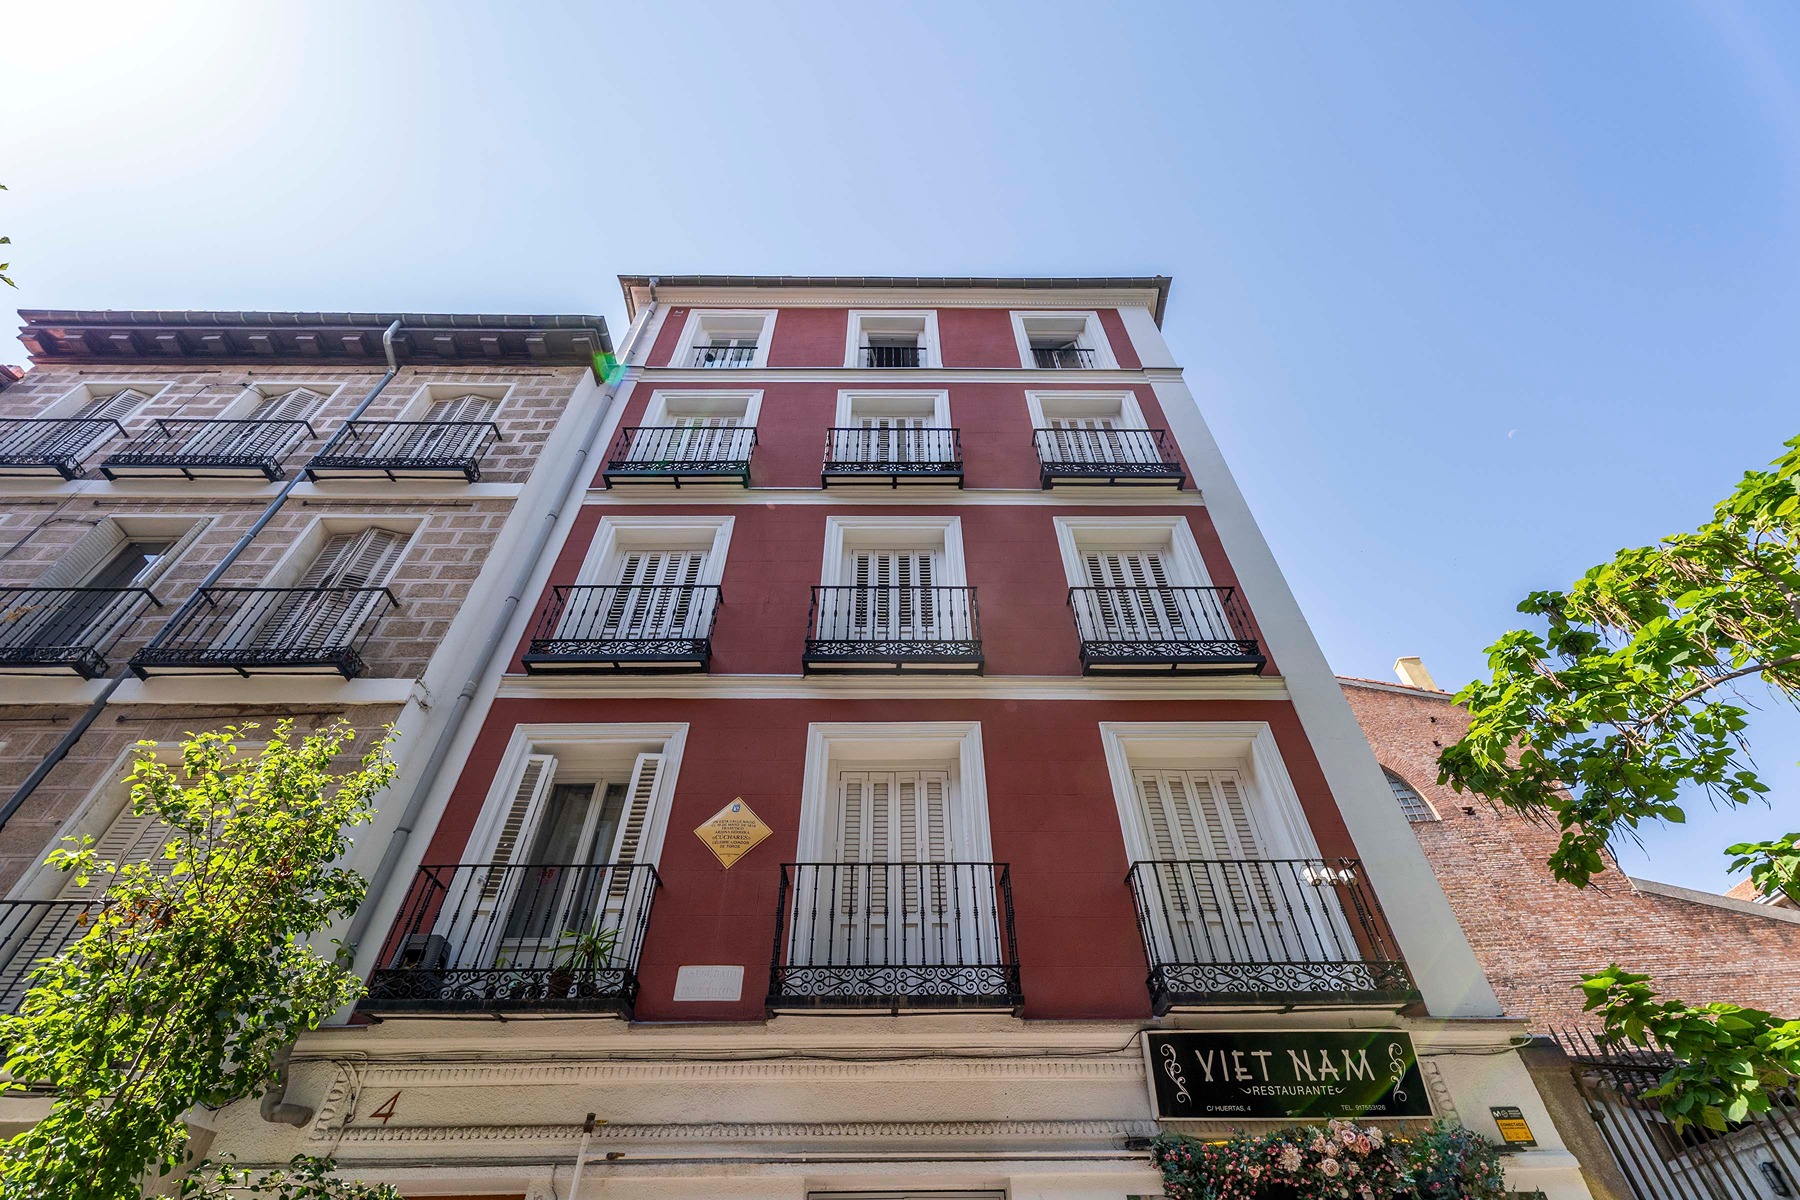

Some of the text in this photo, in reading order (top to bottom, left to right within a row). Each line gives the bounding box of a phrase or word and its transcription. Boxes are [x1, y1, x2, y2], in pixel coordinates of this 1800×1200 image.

[1194, 1049, 1375, 1081] VIET NAM
[1252, 1085, 1335, 1096] RESTAURANTE
[369, 1090, 401, 1125] 4
